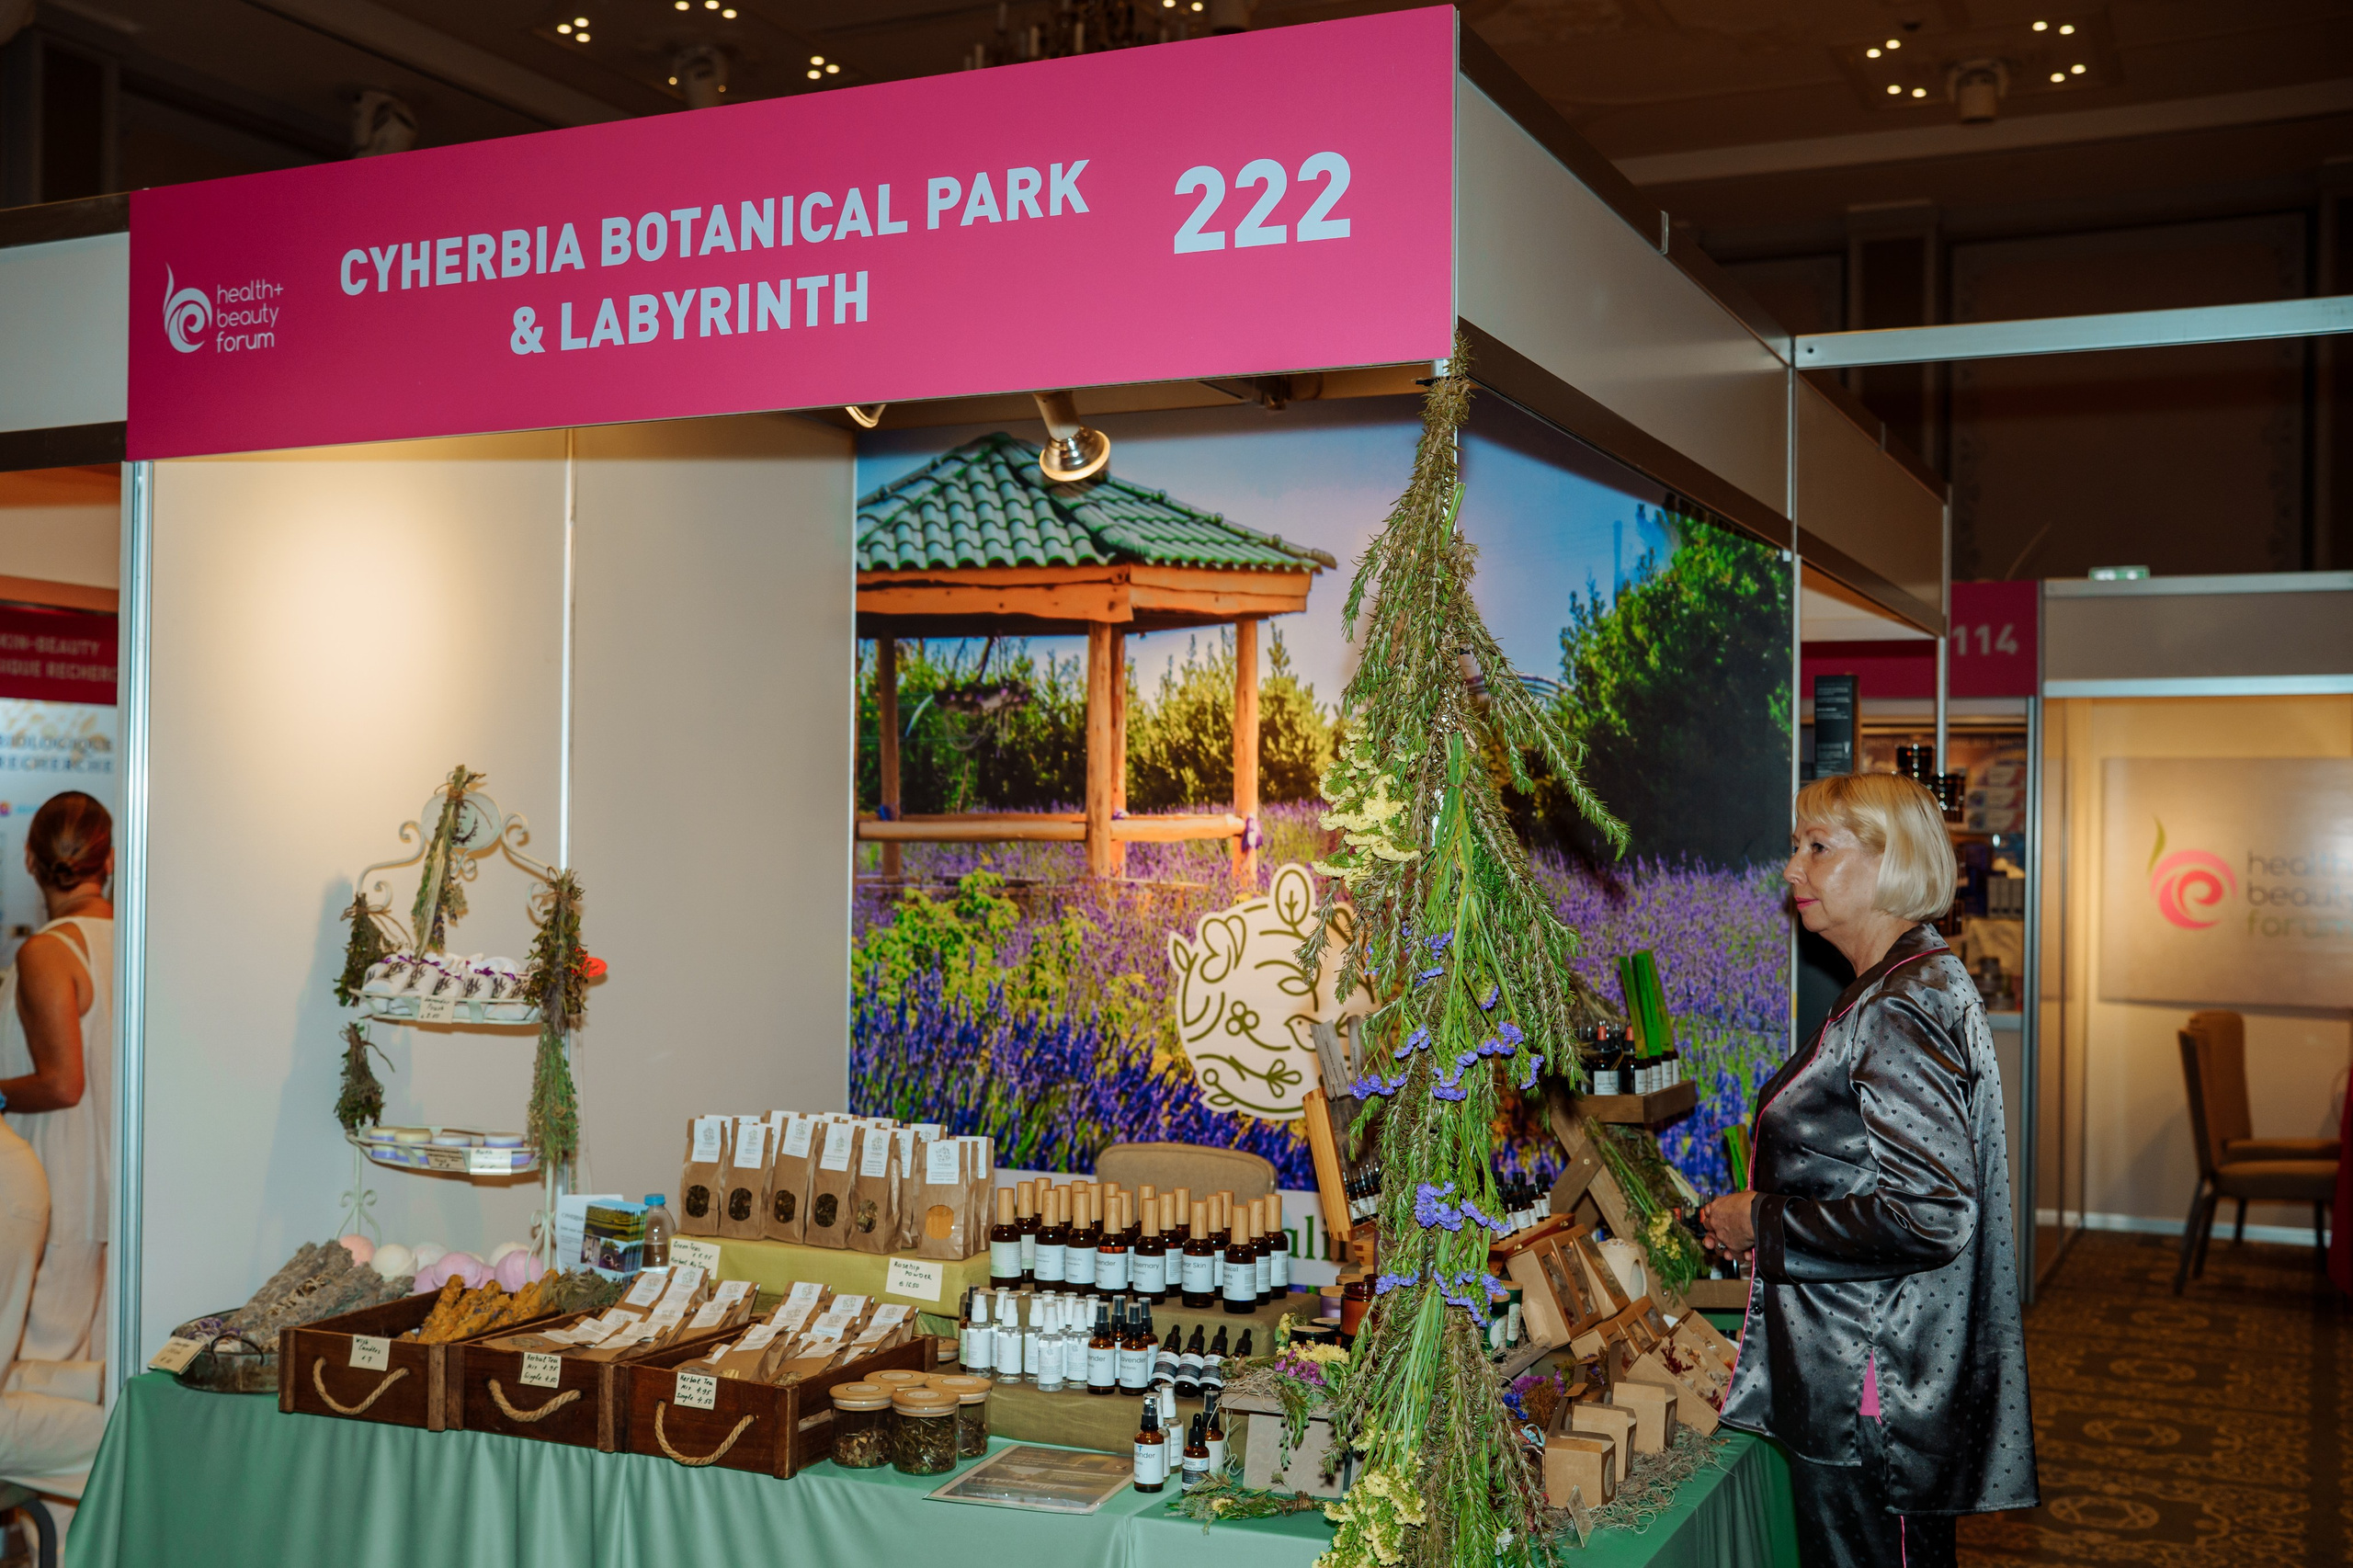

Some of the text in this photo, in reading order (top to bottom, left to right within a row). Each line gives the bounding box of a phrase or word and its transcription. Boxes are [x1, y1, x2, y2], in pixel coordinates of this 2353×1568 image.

[1174, 152, 1351, 255] 222
[340, 159, 1090, 296] CYHERBIA BOTANICAL PARK
[217, 278, 284, 304] health+
[217, 302, 279, 328] beauty
[510, 270, 869, 356] & LABYRINTH
[216, 331, 275, 354] forum
[1951, 622, 2018, 656] 114
[894, 1261, 920, 1272] Rosehip
[527, 1354, 547, 1363] Herbal
[524, 1371, 542, 1383] Single
[679, 1374, 713, 1386] Herbal Tea
[676, 1392, 713, 1404] Single 4.50
